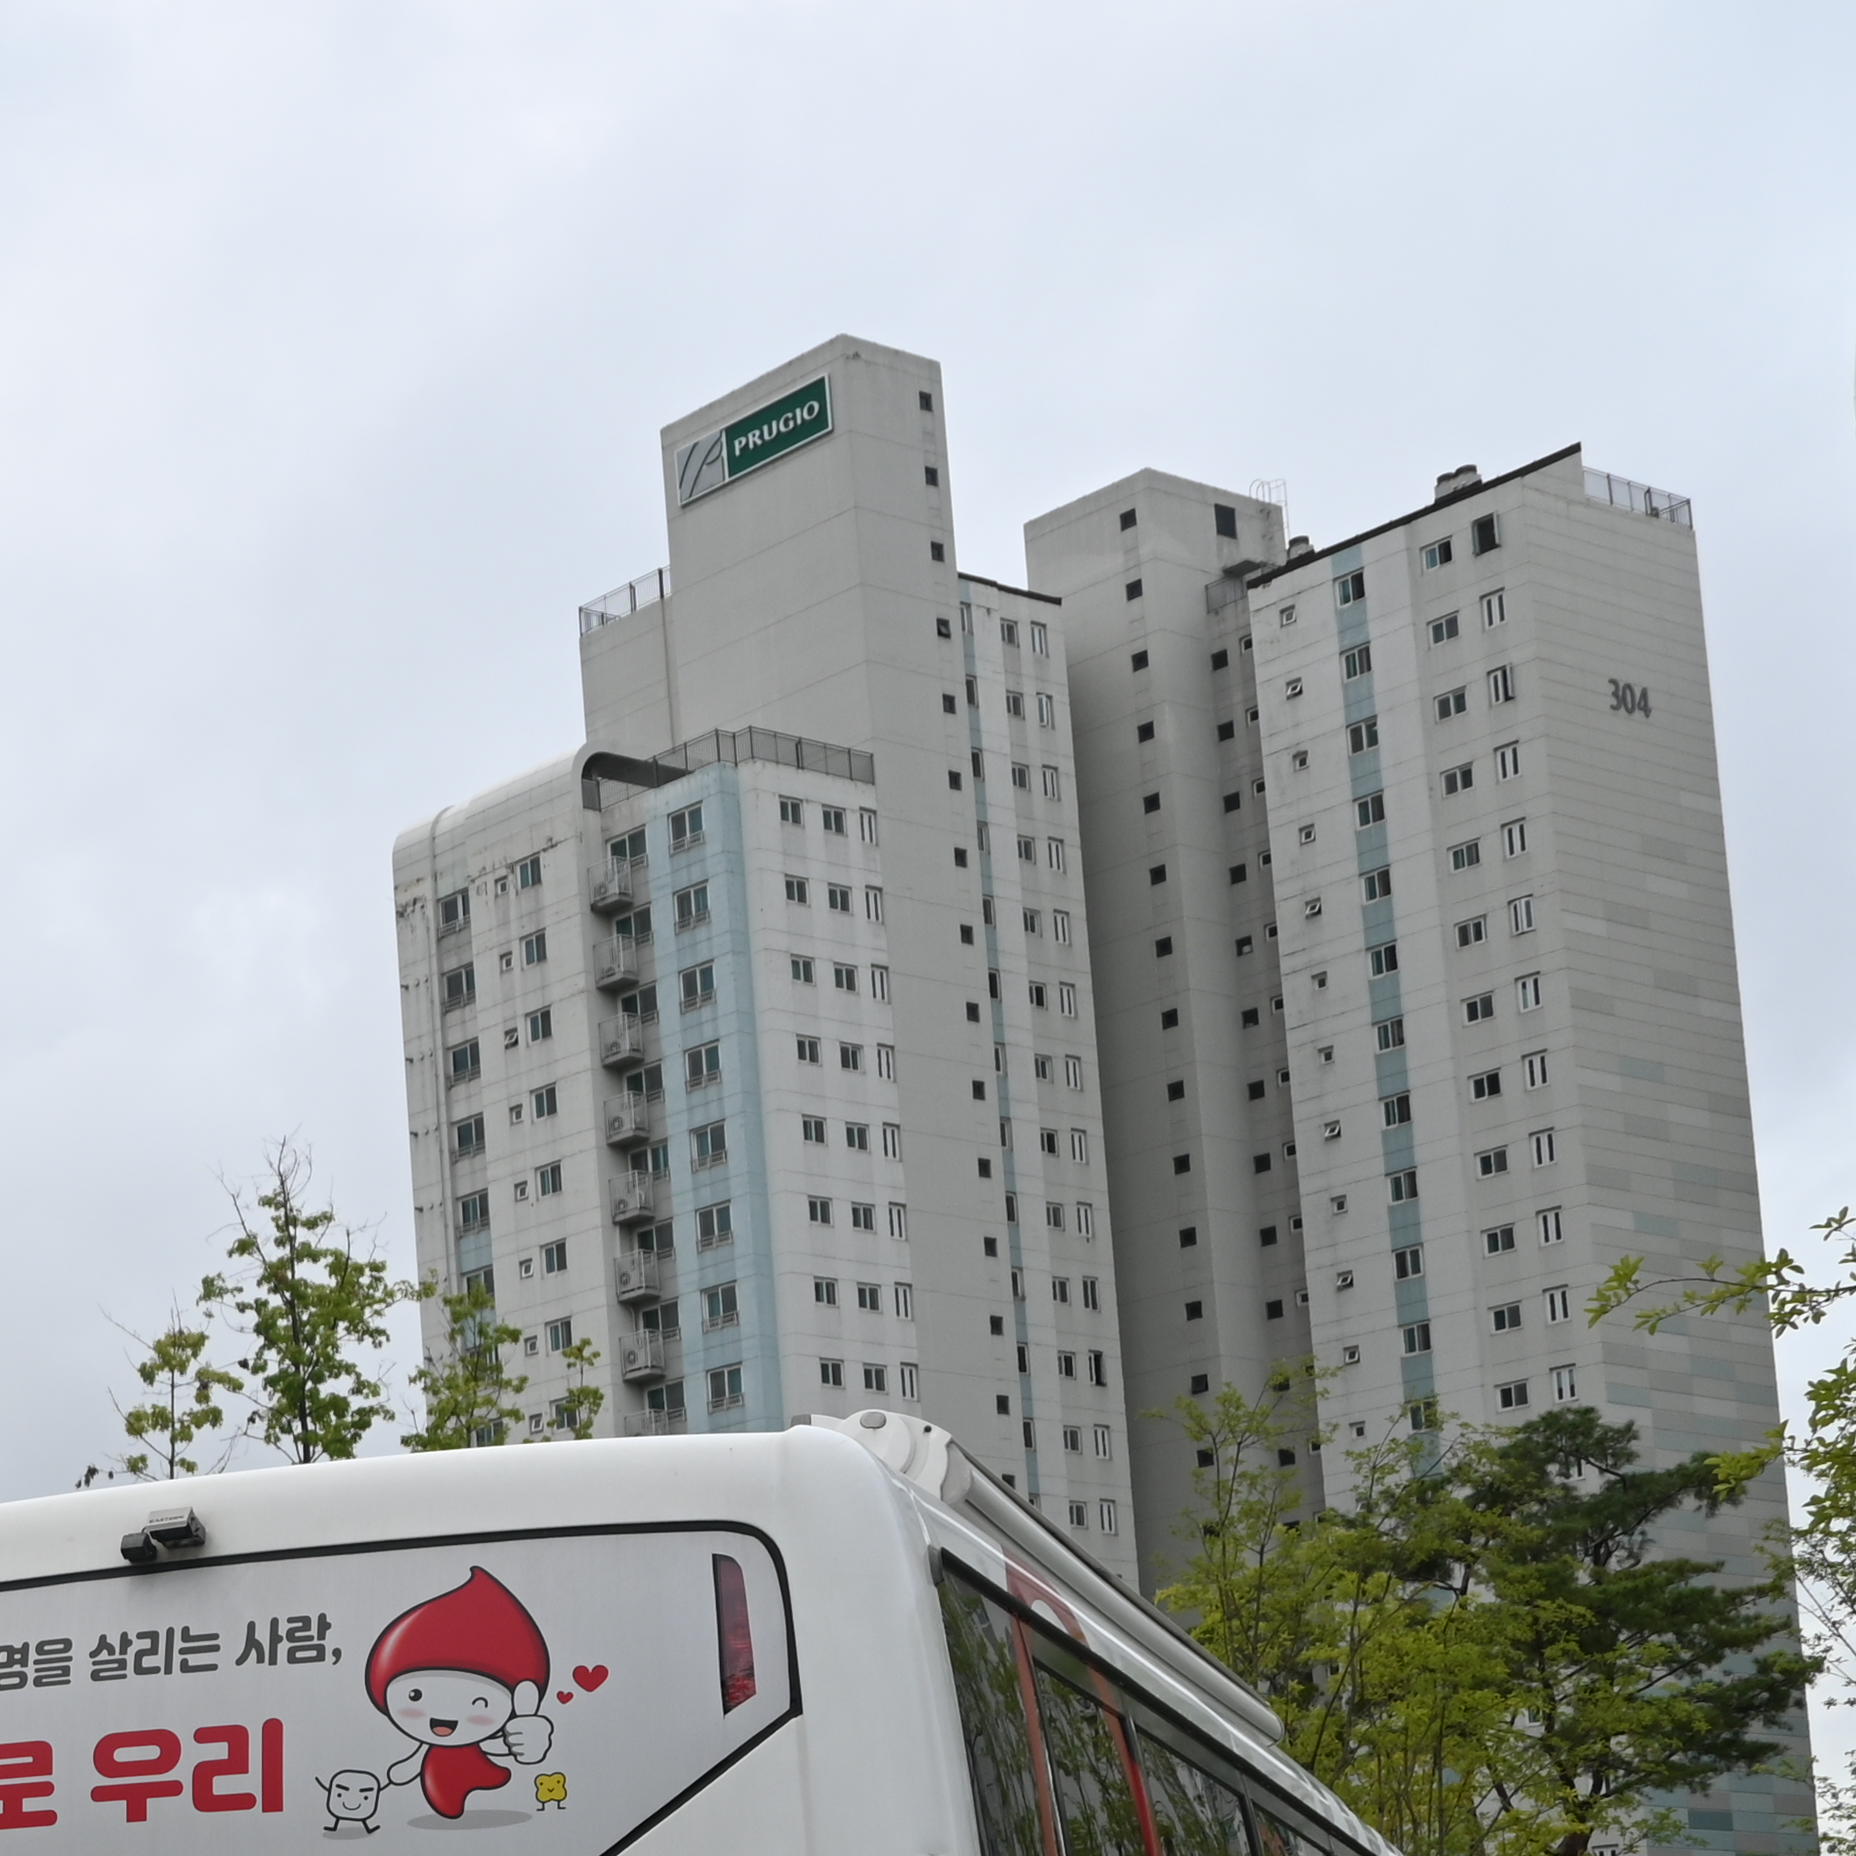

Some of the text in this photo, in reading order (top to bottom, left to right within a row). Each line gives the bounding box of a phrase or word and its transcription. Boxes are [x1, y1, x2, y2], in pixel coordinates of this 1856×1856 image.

[733, 400, 821, 457] PRUGIO
[1607, 677, 1653, 720] 304
[89, 1625, 222, 1682] 살리는
[235, 1612, 343, 1667] 사람,
[89, 1717, 285, 1823] 우리
